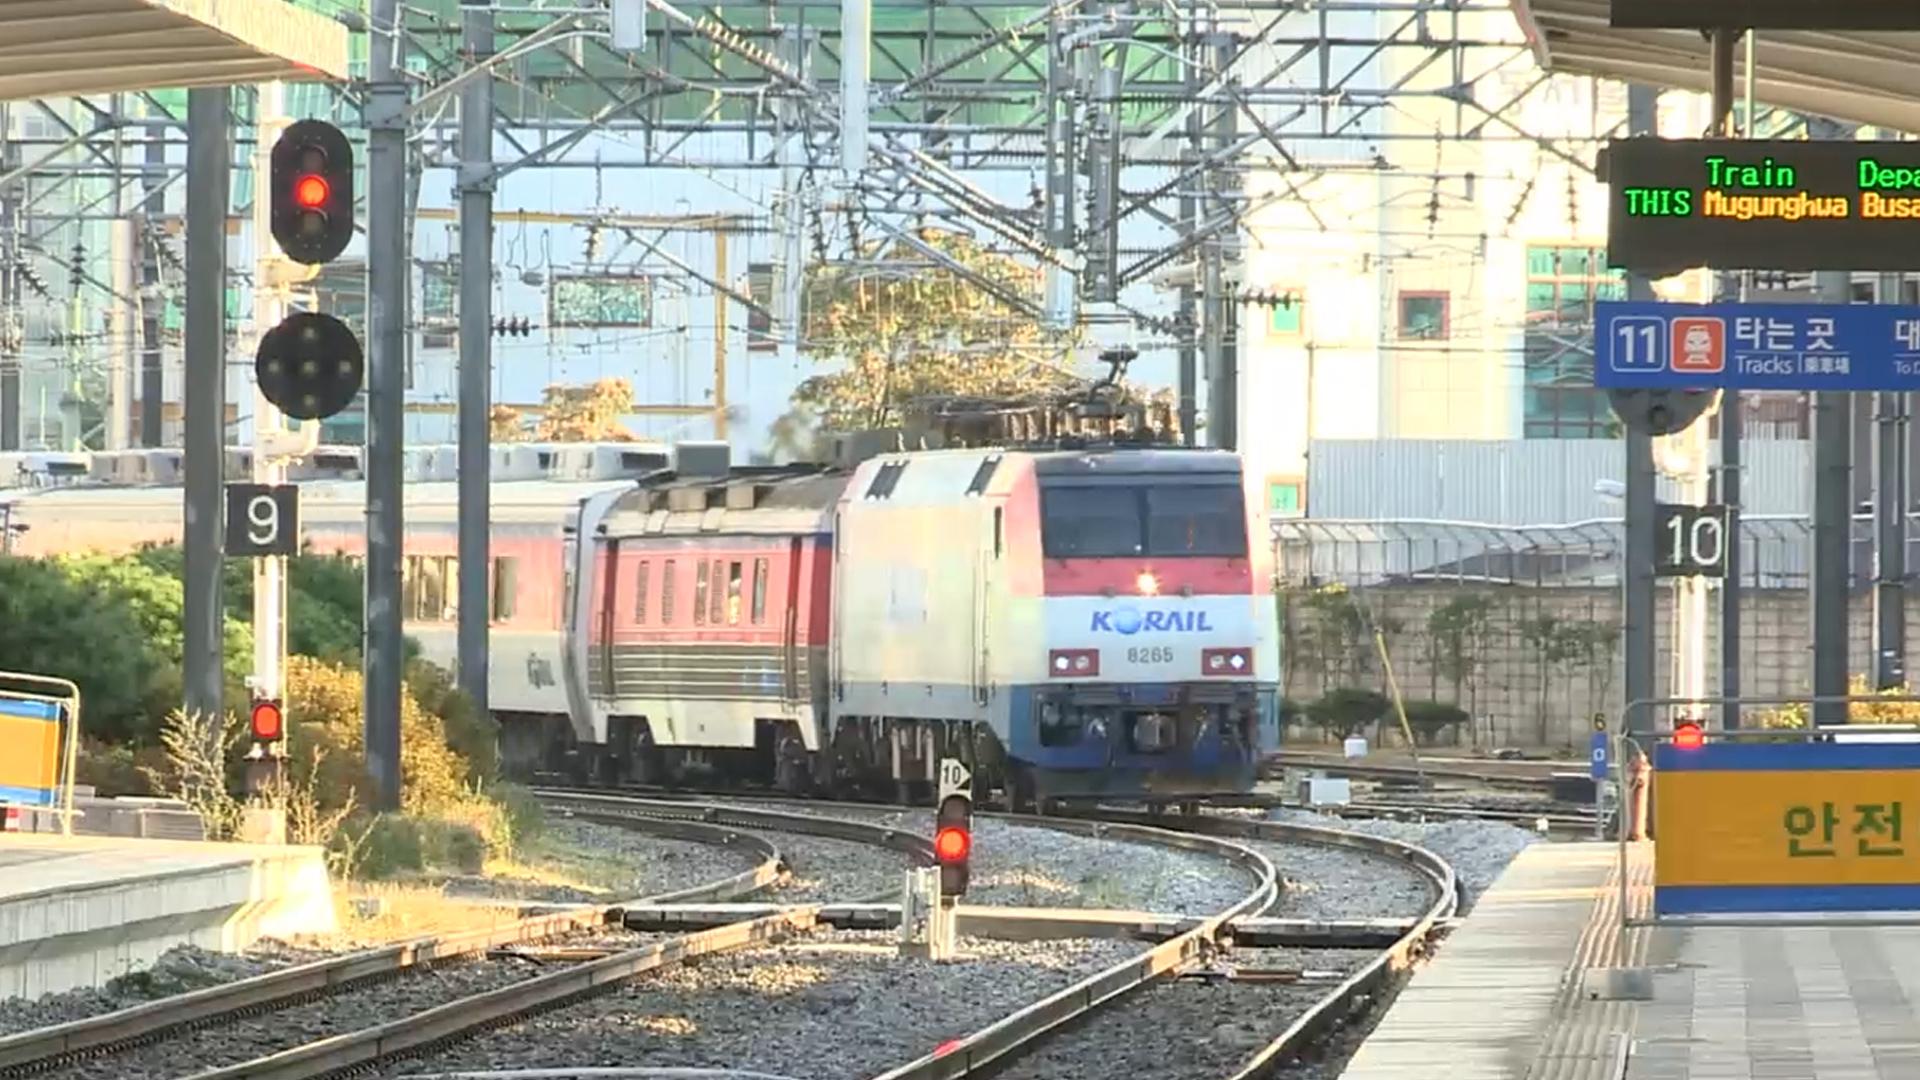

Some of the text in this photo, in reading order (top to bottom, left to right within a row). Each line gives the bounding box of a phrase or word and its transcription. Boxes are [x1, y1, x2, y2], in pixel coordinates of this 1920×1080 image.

[1706, 158, 1794, 186] Train
[1625, 190, 1690, 214] THIS
[1704, 190, 1849, 220] Mugunghwa
[1618, 325, 1656, 364] 11
[1735, 317, 1835, 350] 타는 곳
[1735, 354, 1793, 375] Tracks
[1893, 361, 1911, 374] To
[247, 495, 279, 545] 9
[1667, 514, 1723, 566] 10
[1091, 606, 1213, 635] KORAIL
[1127, 648, 1174, 664] 8265
[943, 765, 961, 785] 10
